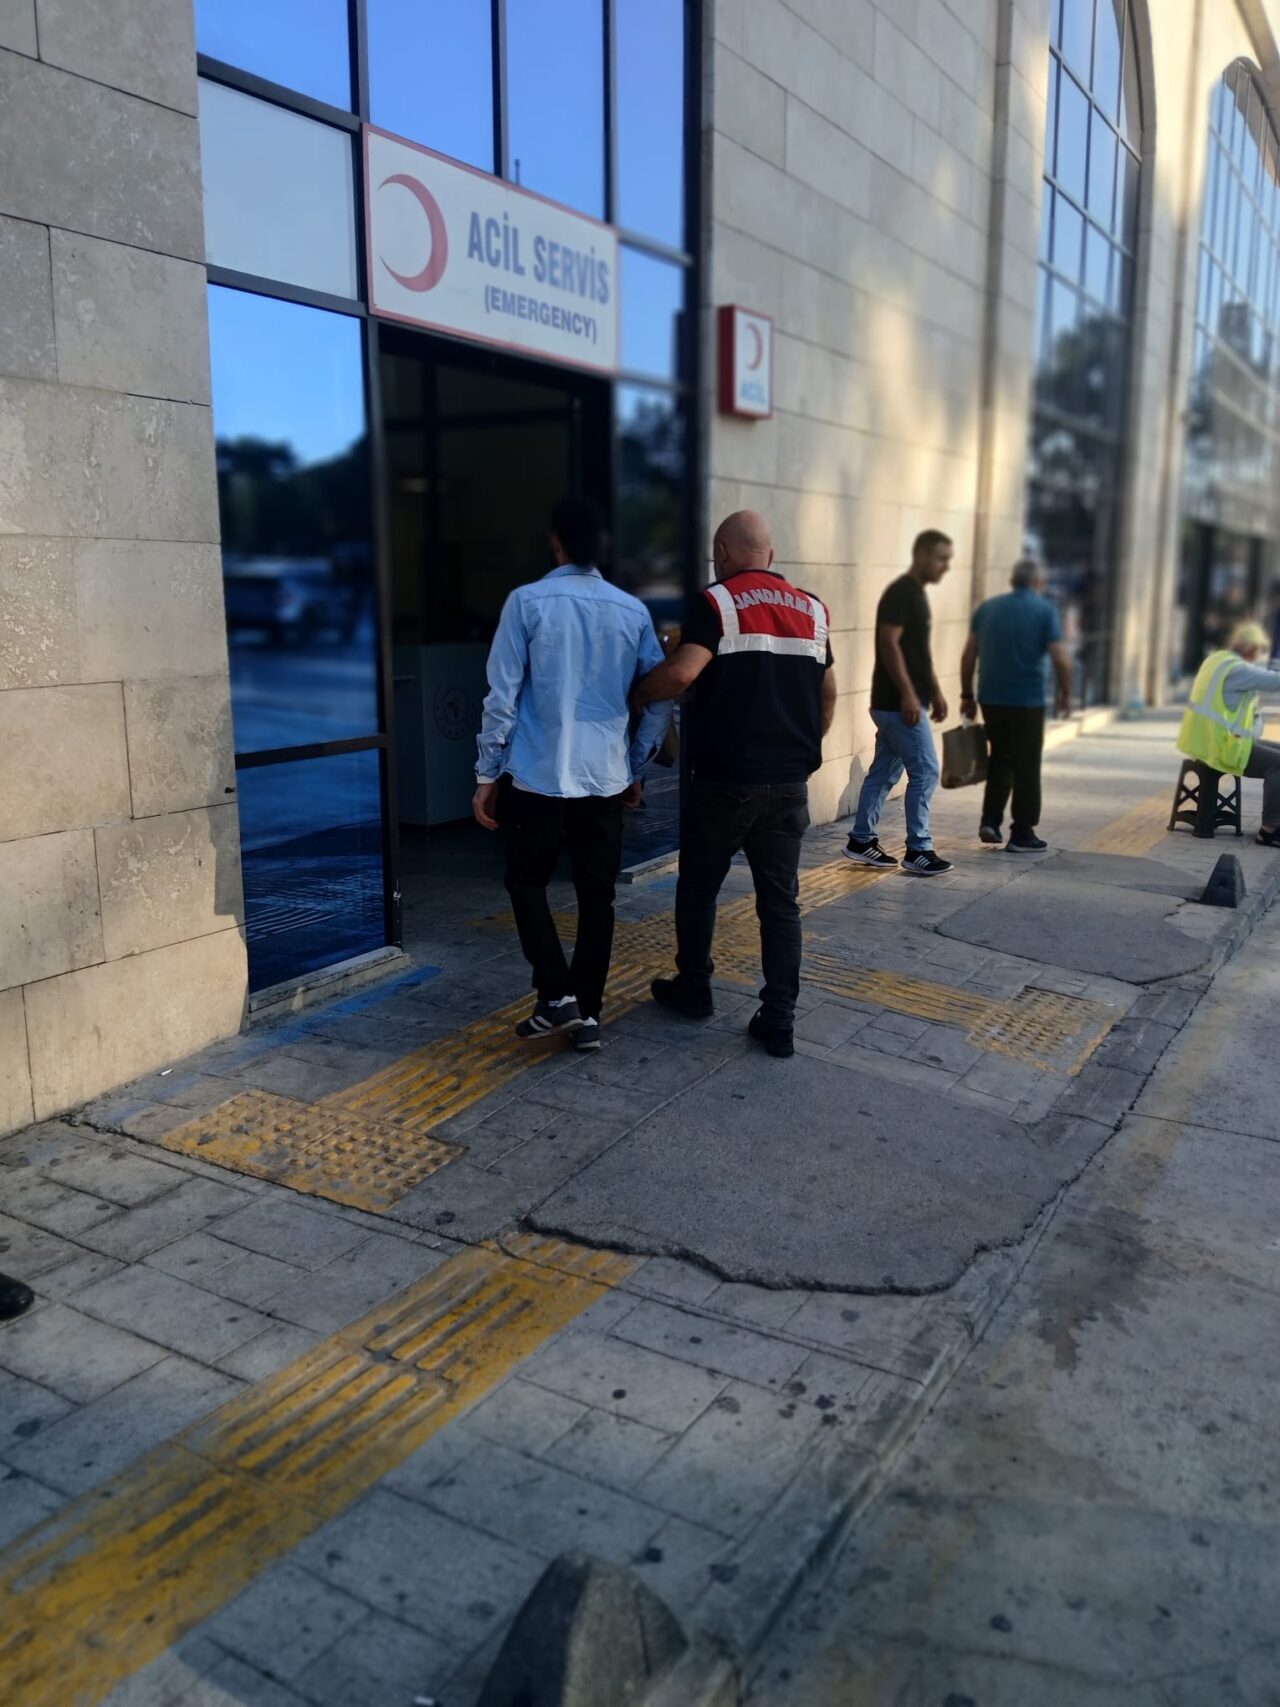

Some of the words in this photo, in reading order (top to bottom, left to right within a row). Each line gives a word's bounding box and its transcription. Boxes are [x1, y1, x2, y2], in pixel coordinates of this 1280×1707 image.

[467, 210, 526, 277] ACİL
[533, 234, 609, 306] SERVİS
[484, 284, 598, 345] (EMERGENCY)
